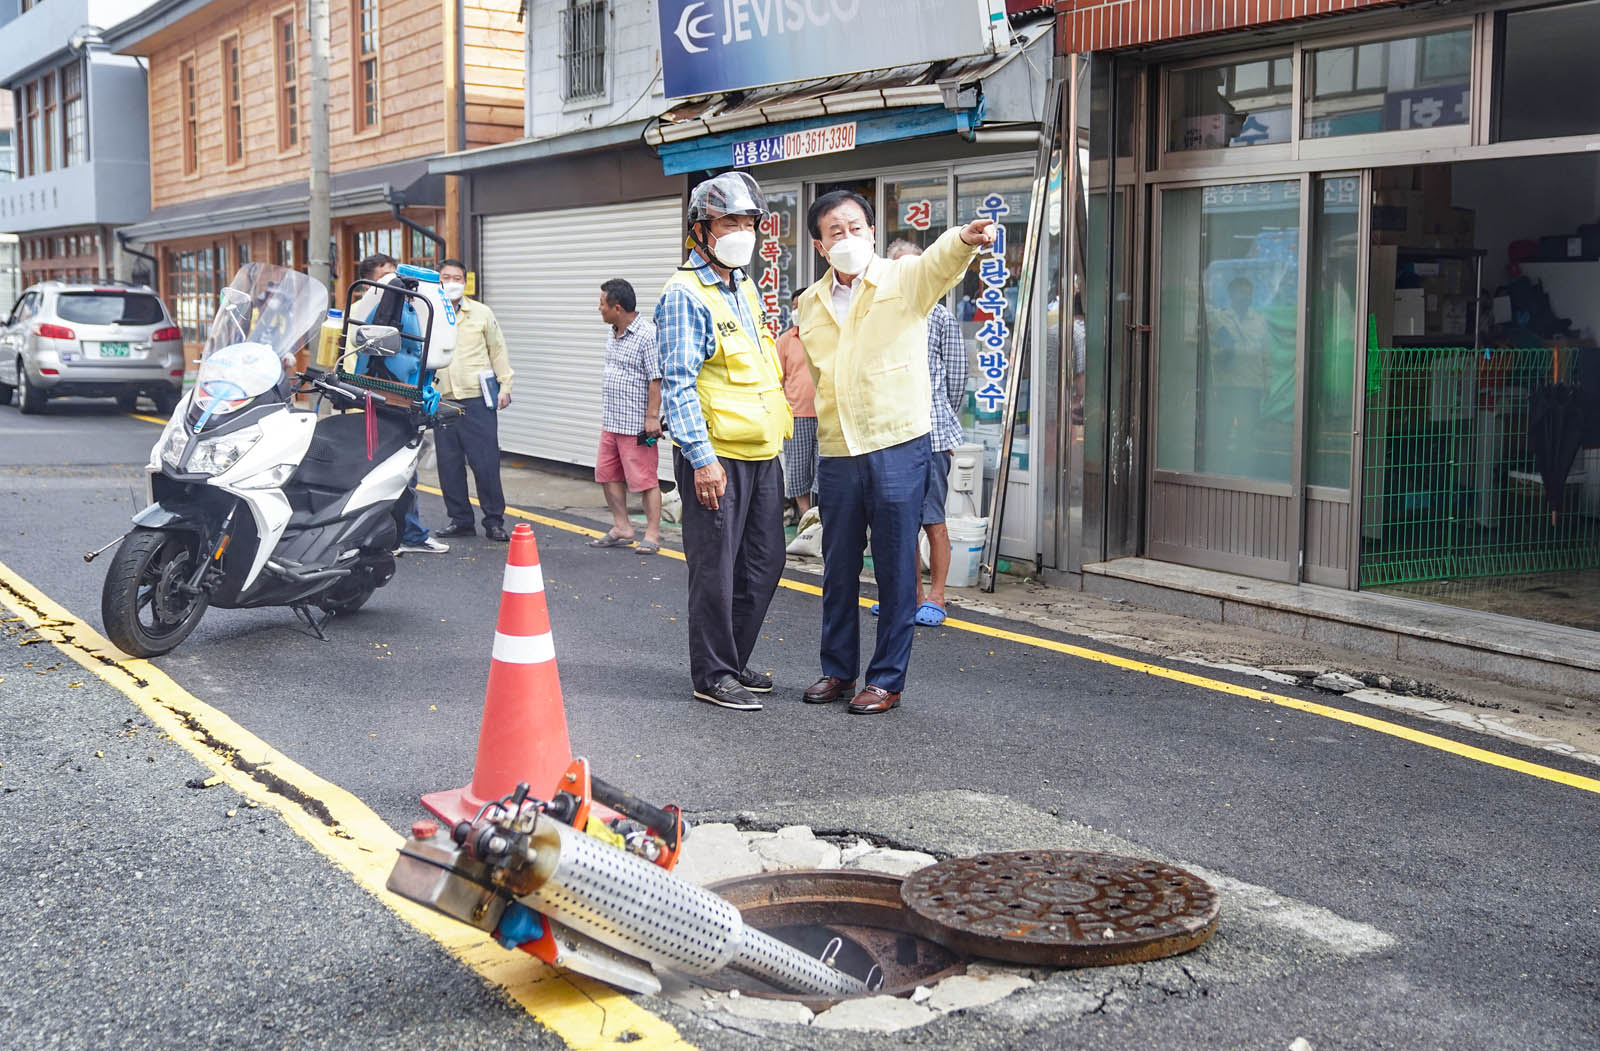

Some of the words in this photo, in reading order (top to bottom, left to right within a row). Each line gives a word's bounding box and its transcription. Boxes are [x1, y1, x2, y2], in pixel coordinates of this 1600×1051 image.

[734, 137, 783, 166] 삼흥상사
[786, 125, 854, 157] 010-3611-3390
[905, 202, 930, 227] 건
